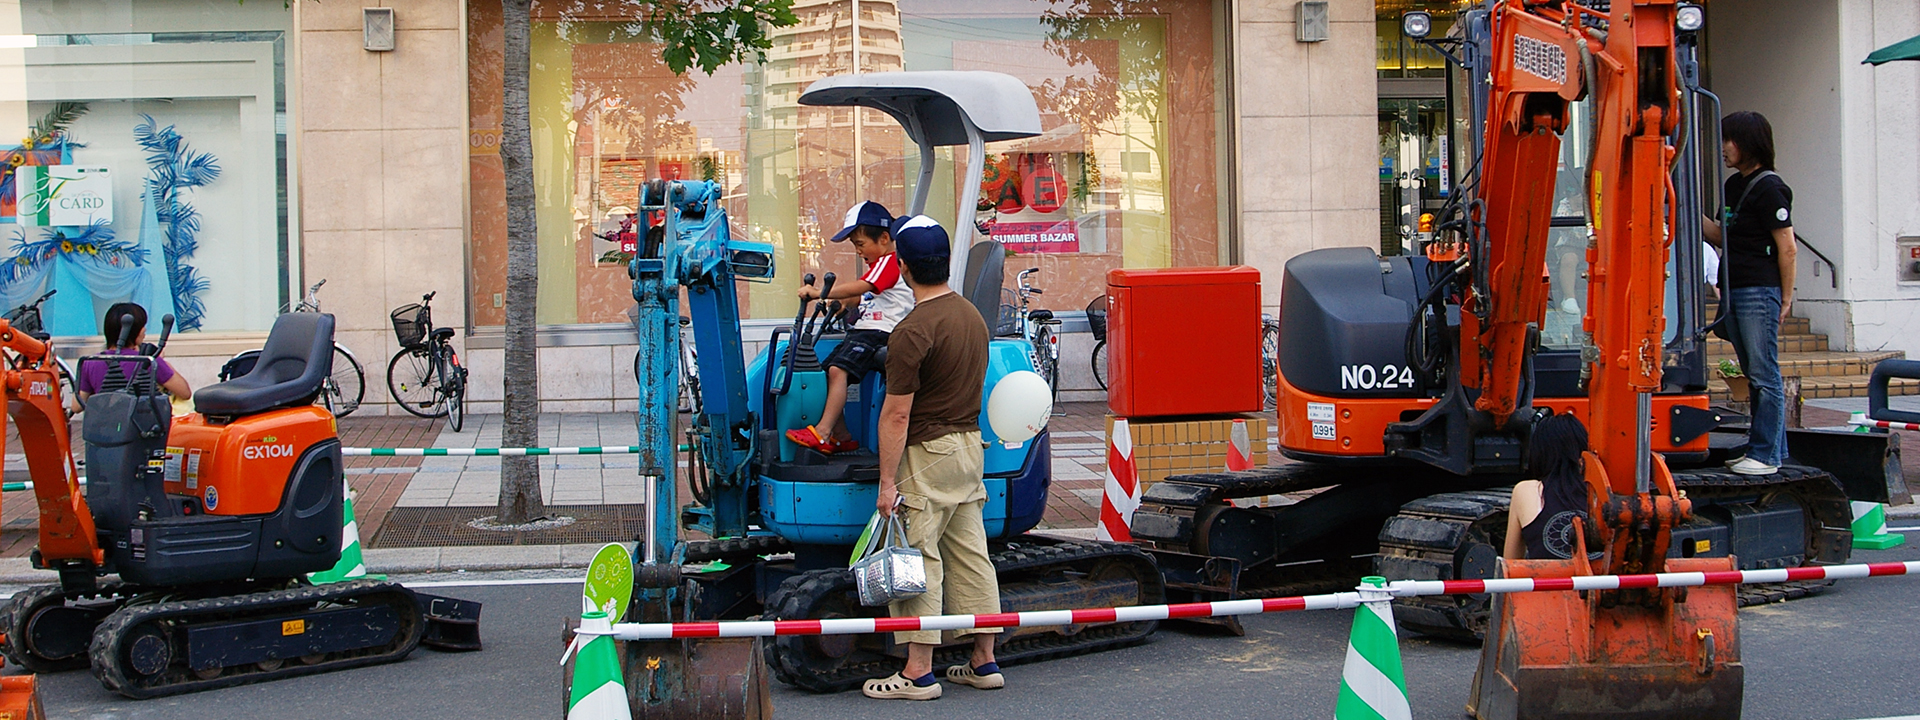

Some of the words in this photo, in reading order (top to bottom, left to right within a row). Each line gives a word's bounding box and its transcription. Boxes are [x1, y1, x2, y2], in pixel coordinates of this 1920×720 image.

[60, 197, 104, 210] CARD
[992, 233, 1038, 244] SUMMER
[1040, 232, 1076, 242] BAZAR
[1341, 364, 1415, 389] NO.24
